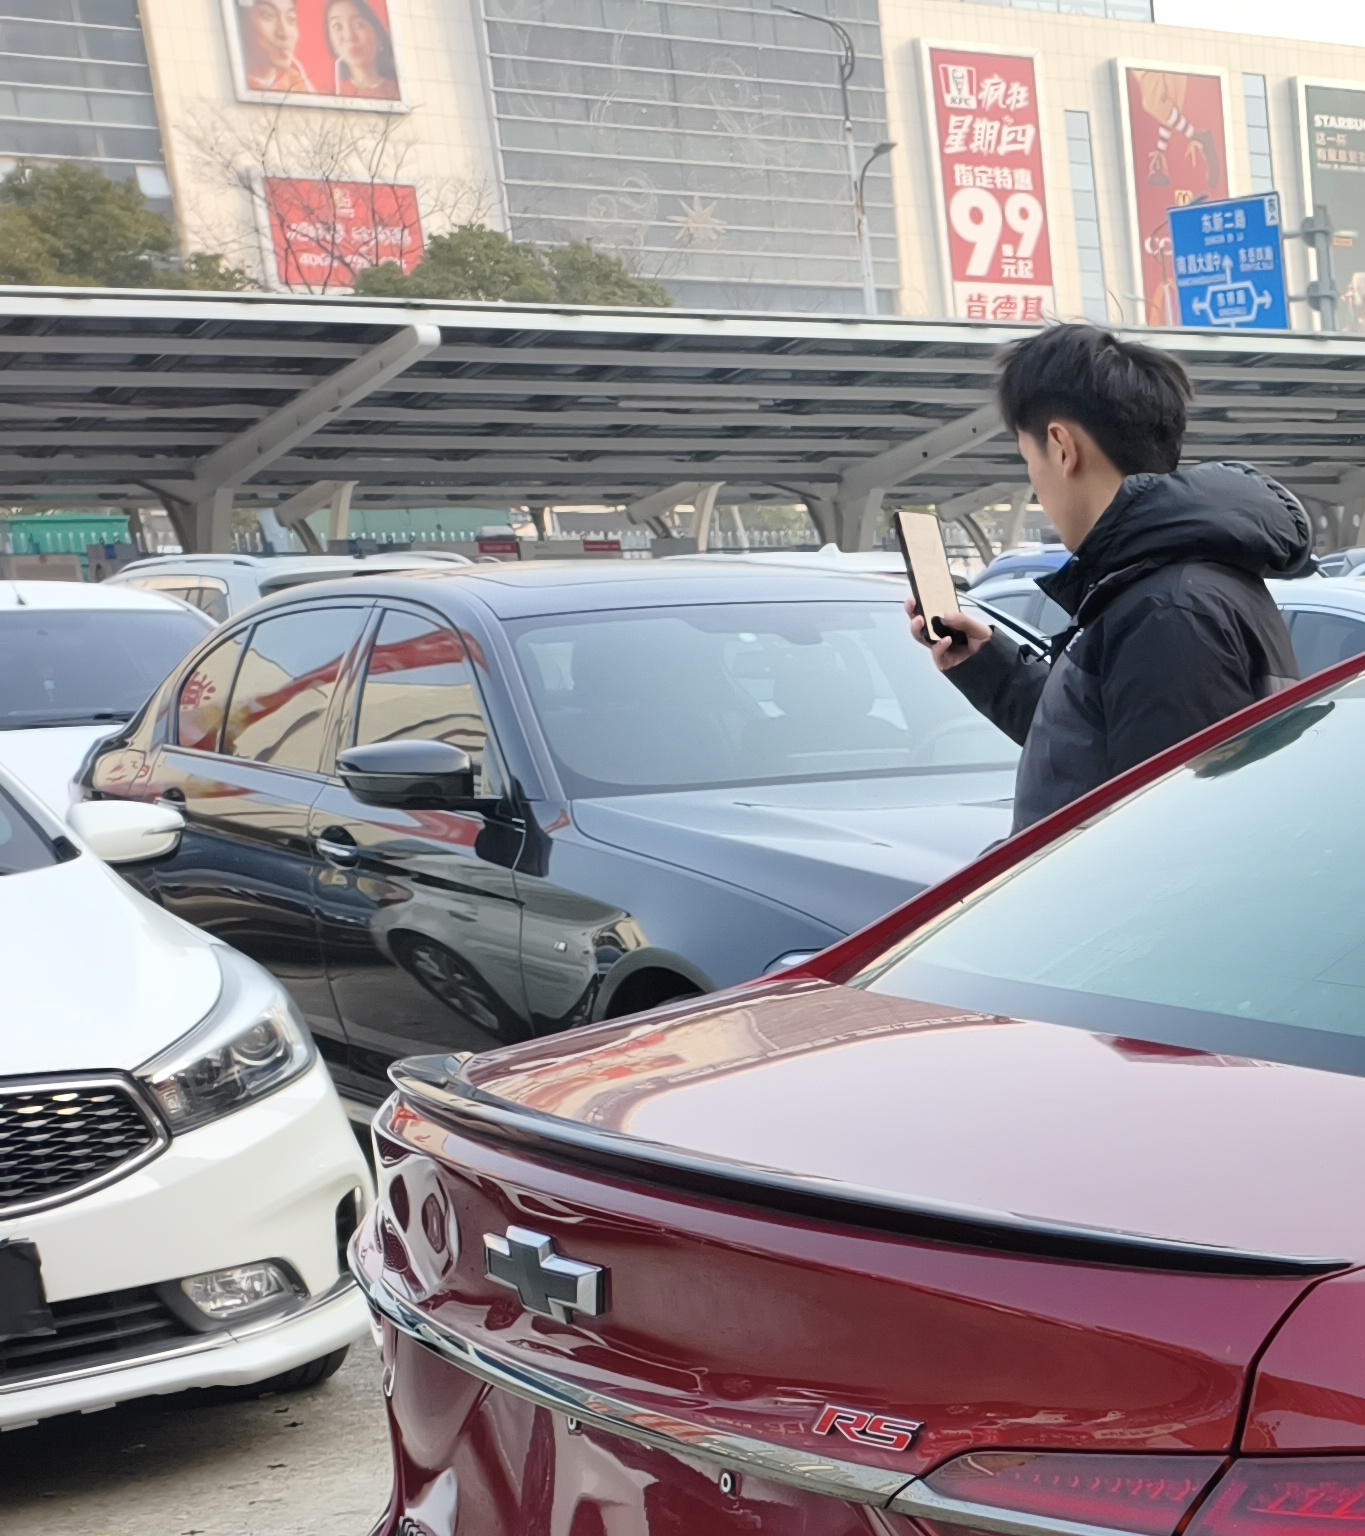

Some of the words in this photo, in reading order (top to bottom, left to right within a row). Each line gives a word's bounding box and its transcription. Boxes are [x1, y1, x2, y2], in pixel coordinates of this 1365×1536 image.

[978, 73, 1030, 112] 疯狂
[943, 114, 1036, 157] 星期四
[954, 163, 1034, 191] 指定特惠
[949, 187, 1044, 277] 9.9
[1001, 258, 1035, 279] 元起
[965, 293, 1044, 321] 肯德基
[812, 1402, 923, 1452] RS
